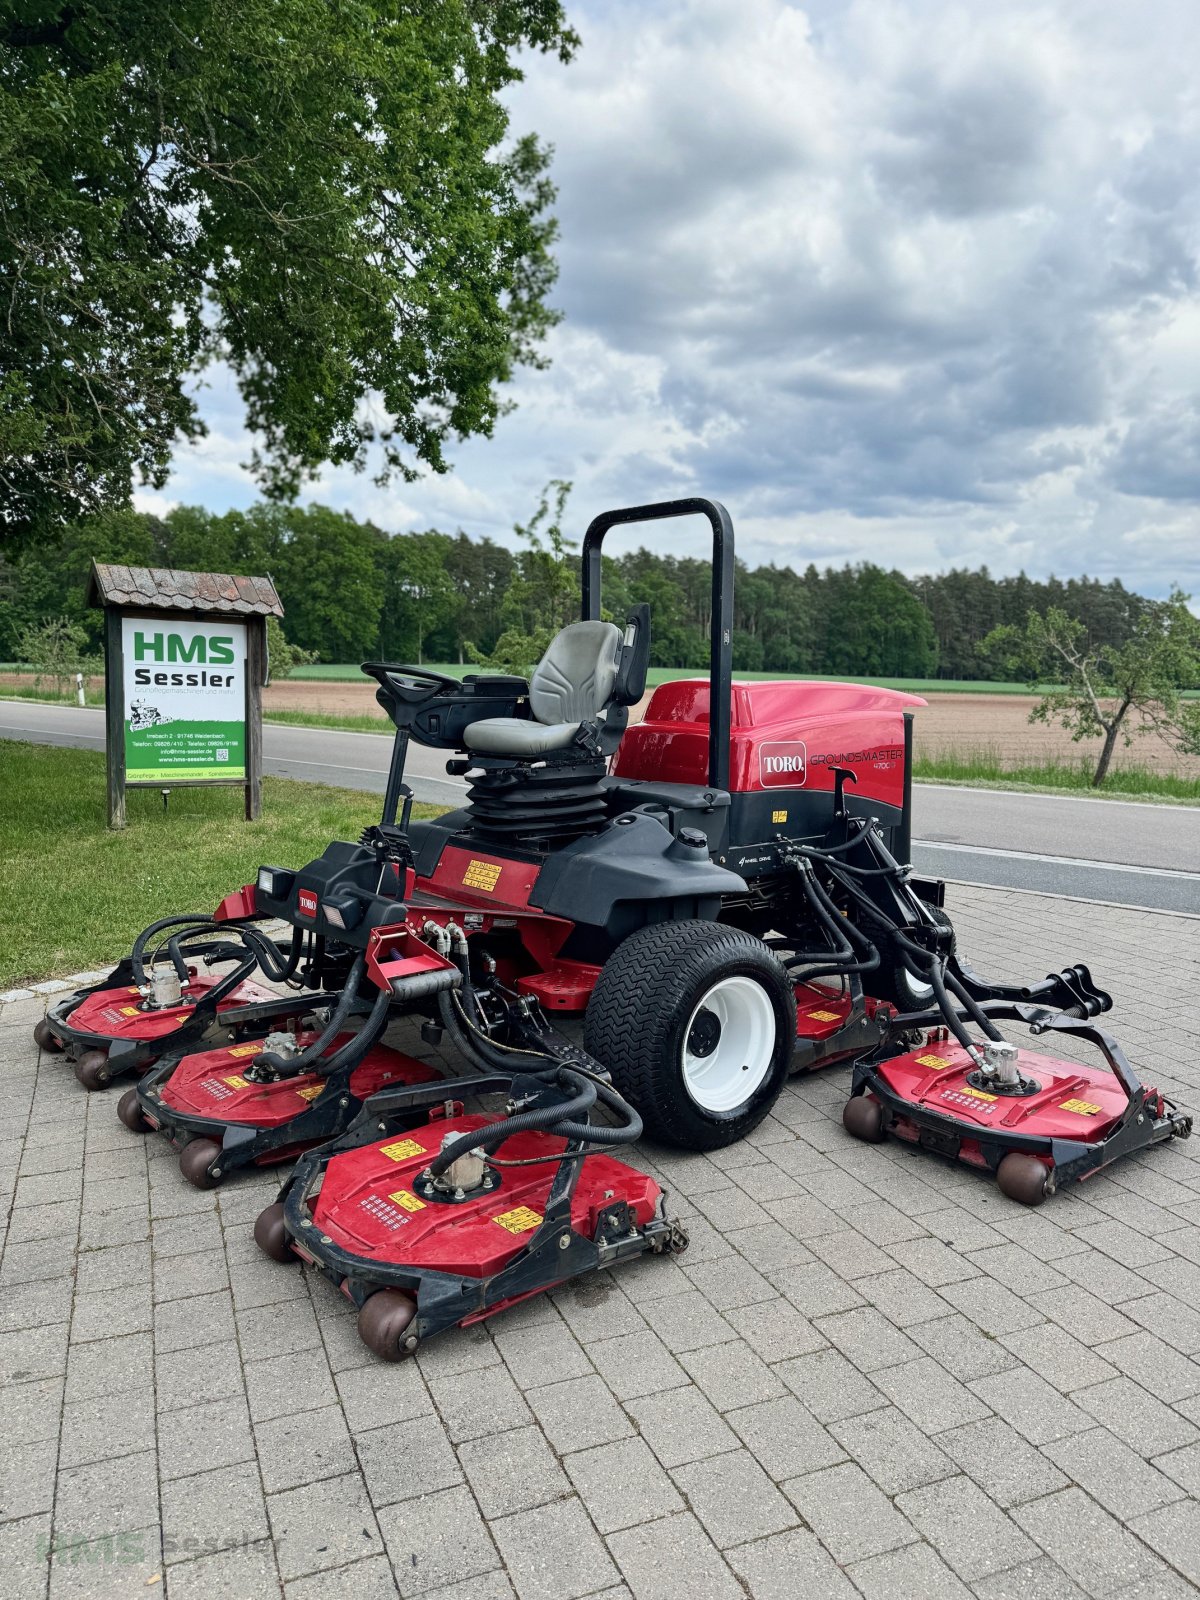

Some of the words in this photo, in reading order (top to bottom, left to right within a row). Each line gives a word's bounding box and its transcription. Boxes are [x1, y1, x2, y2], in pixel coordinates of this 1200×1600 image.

[134, 631, 235, 665] HMS
[135, 668, 235, 687] Sessler
[764, 755, 804, 773] TORO
[810, 749, 903, 766] GROUNDSMASTER
[300, 896, 317, 911] TORO
